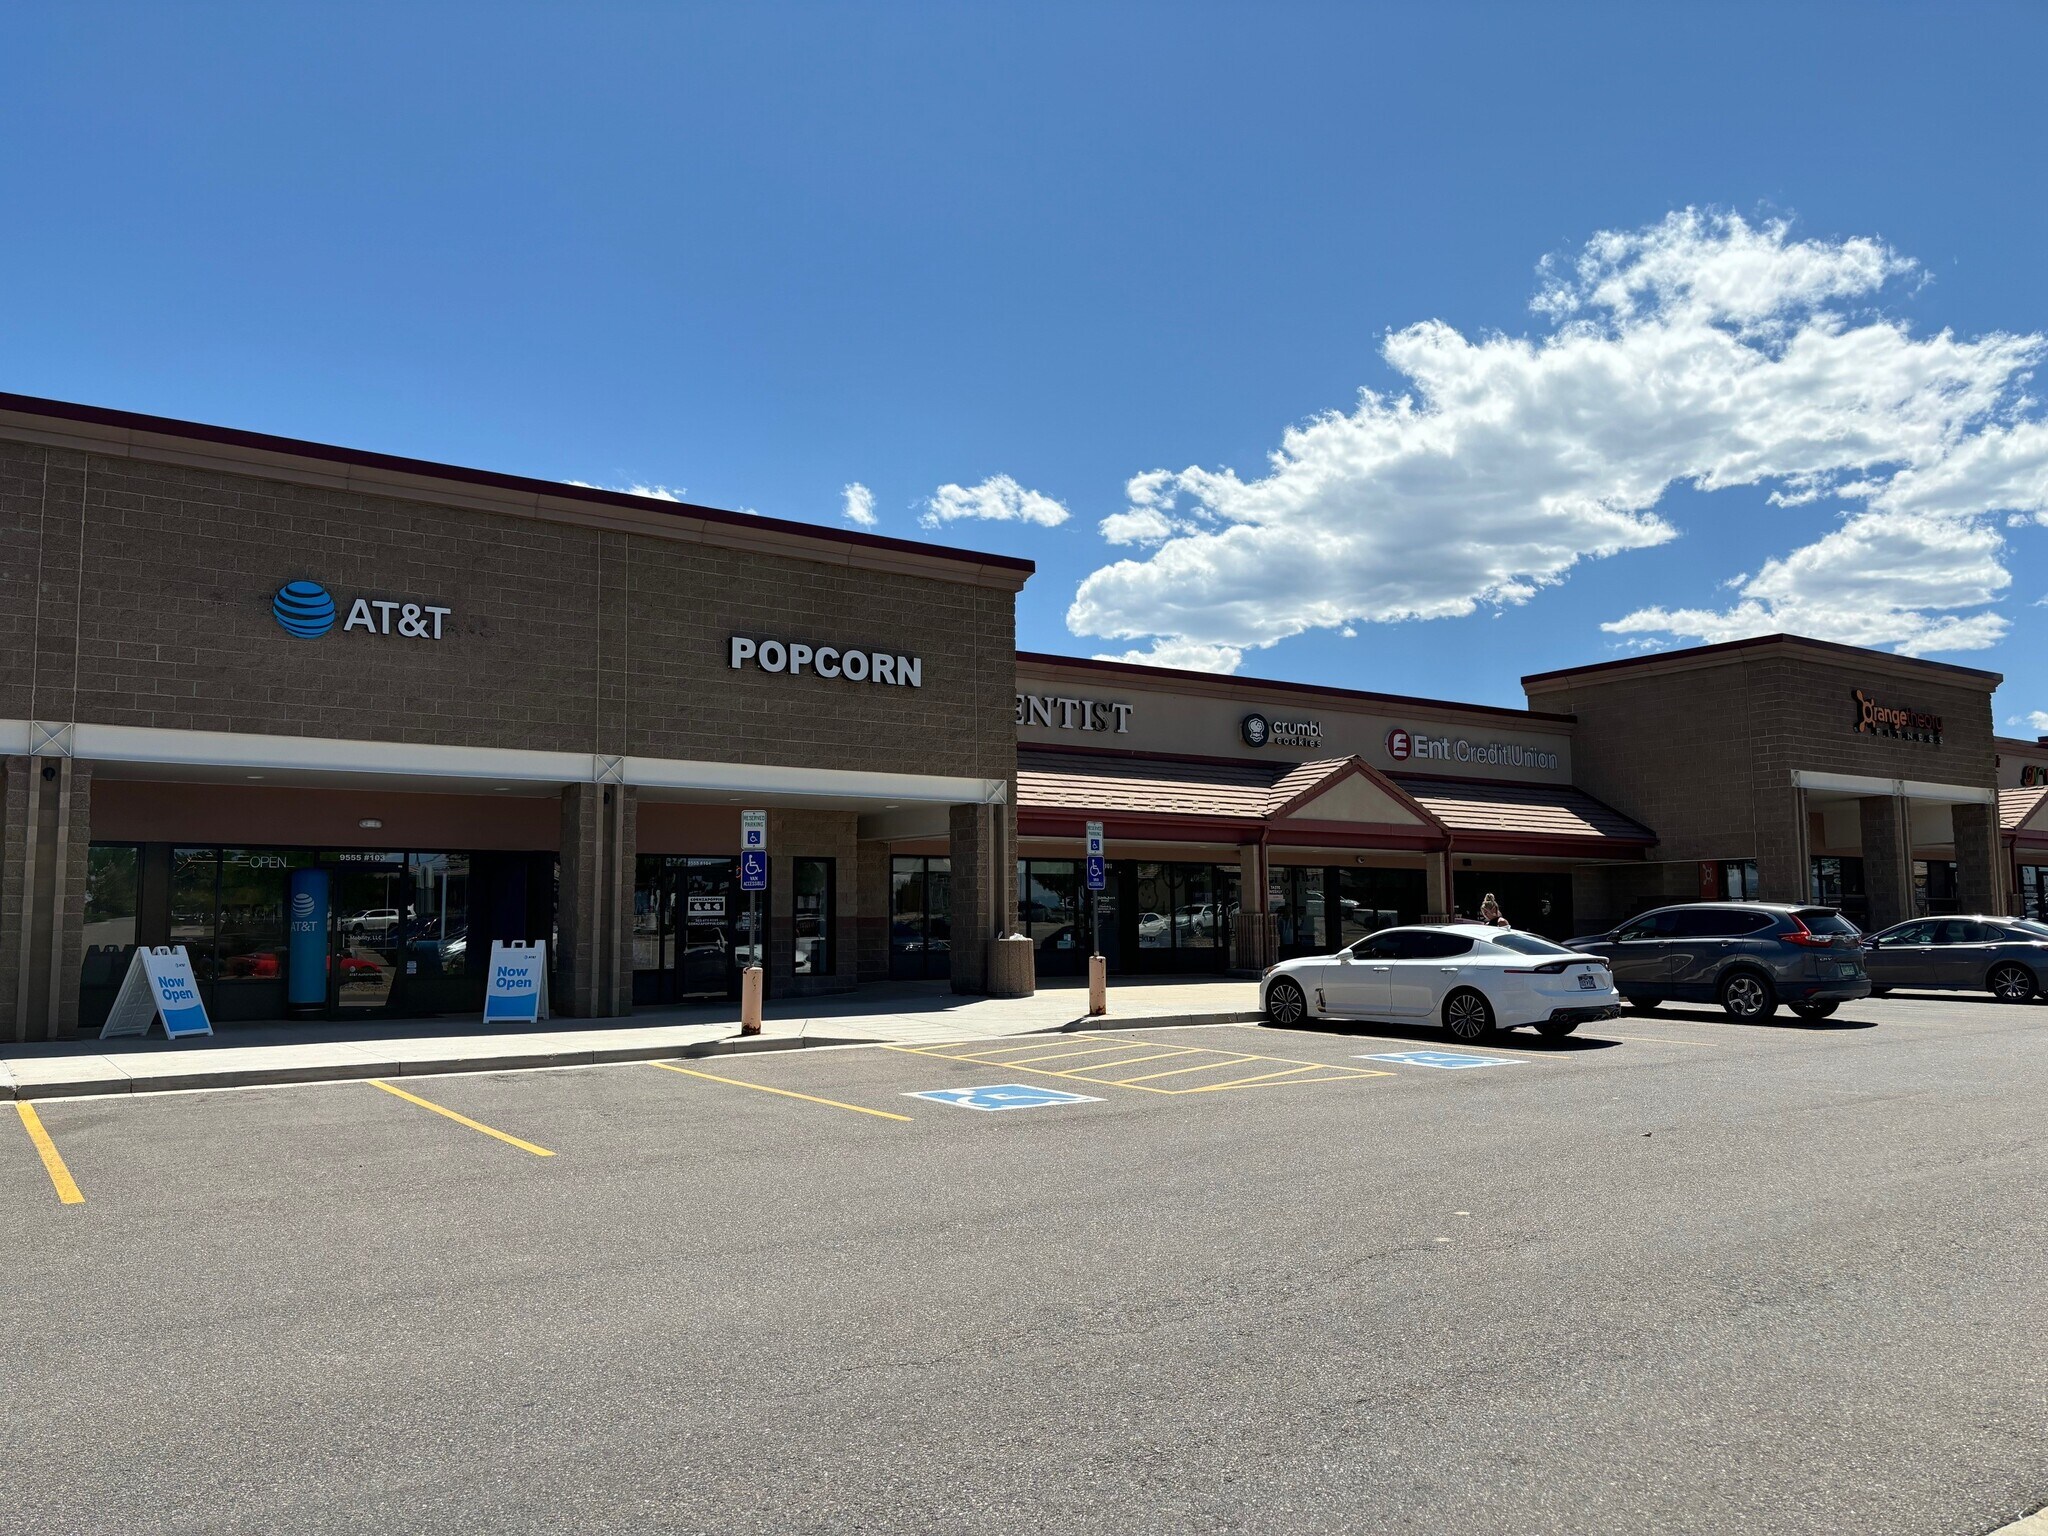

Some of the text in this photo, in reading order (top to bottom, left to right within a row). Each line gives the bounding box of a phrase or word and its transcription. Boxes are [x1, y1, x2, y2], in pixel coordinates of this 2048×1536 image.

[343, 598, 452, 640] AT&T
[730, 636, 922, 687] POPCORN
[1273, 721, 1324, 737] crumbl
[1875, 728, 1944, 744] FITNESS
[1276, 737, 1322, 748] cookies
[1413, 735, 1558, 769] Ent Credit Union
[249, 856, 287, 869] OPEN
[291, 920, 318, 932] AT&T
[497, 966, 528, 977] Now
[158, 976, 185, 988] Now
[496, 978, 532, 990] Open
[162, 988, 194, 1003] Open
